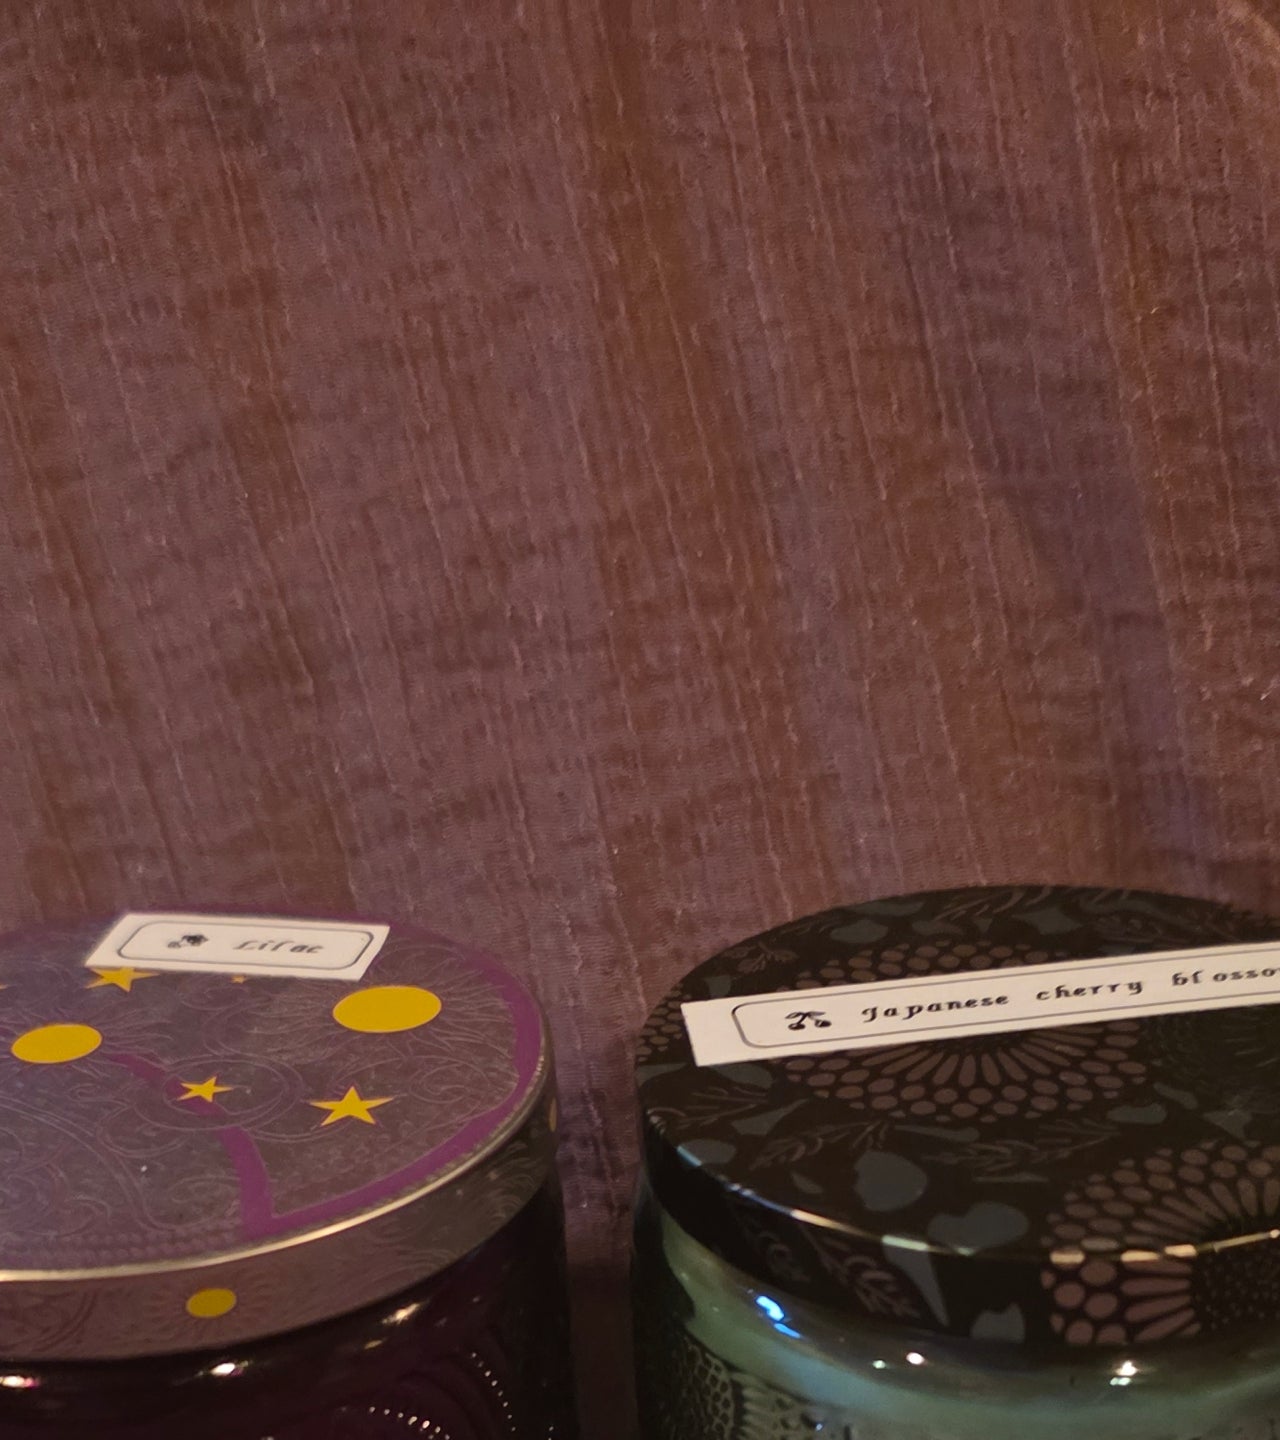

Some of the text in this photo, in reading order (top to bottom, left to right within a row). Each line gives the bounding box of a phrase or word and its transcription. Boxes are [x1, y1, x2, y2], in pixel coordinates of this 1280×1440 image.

[233, 940, 324, 954] Lilac
[860, 993, 1010, 1023] Japanese
[1035, 978, 1144, 1001] cherry
